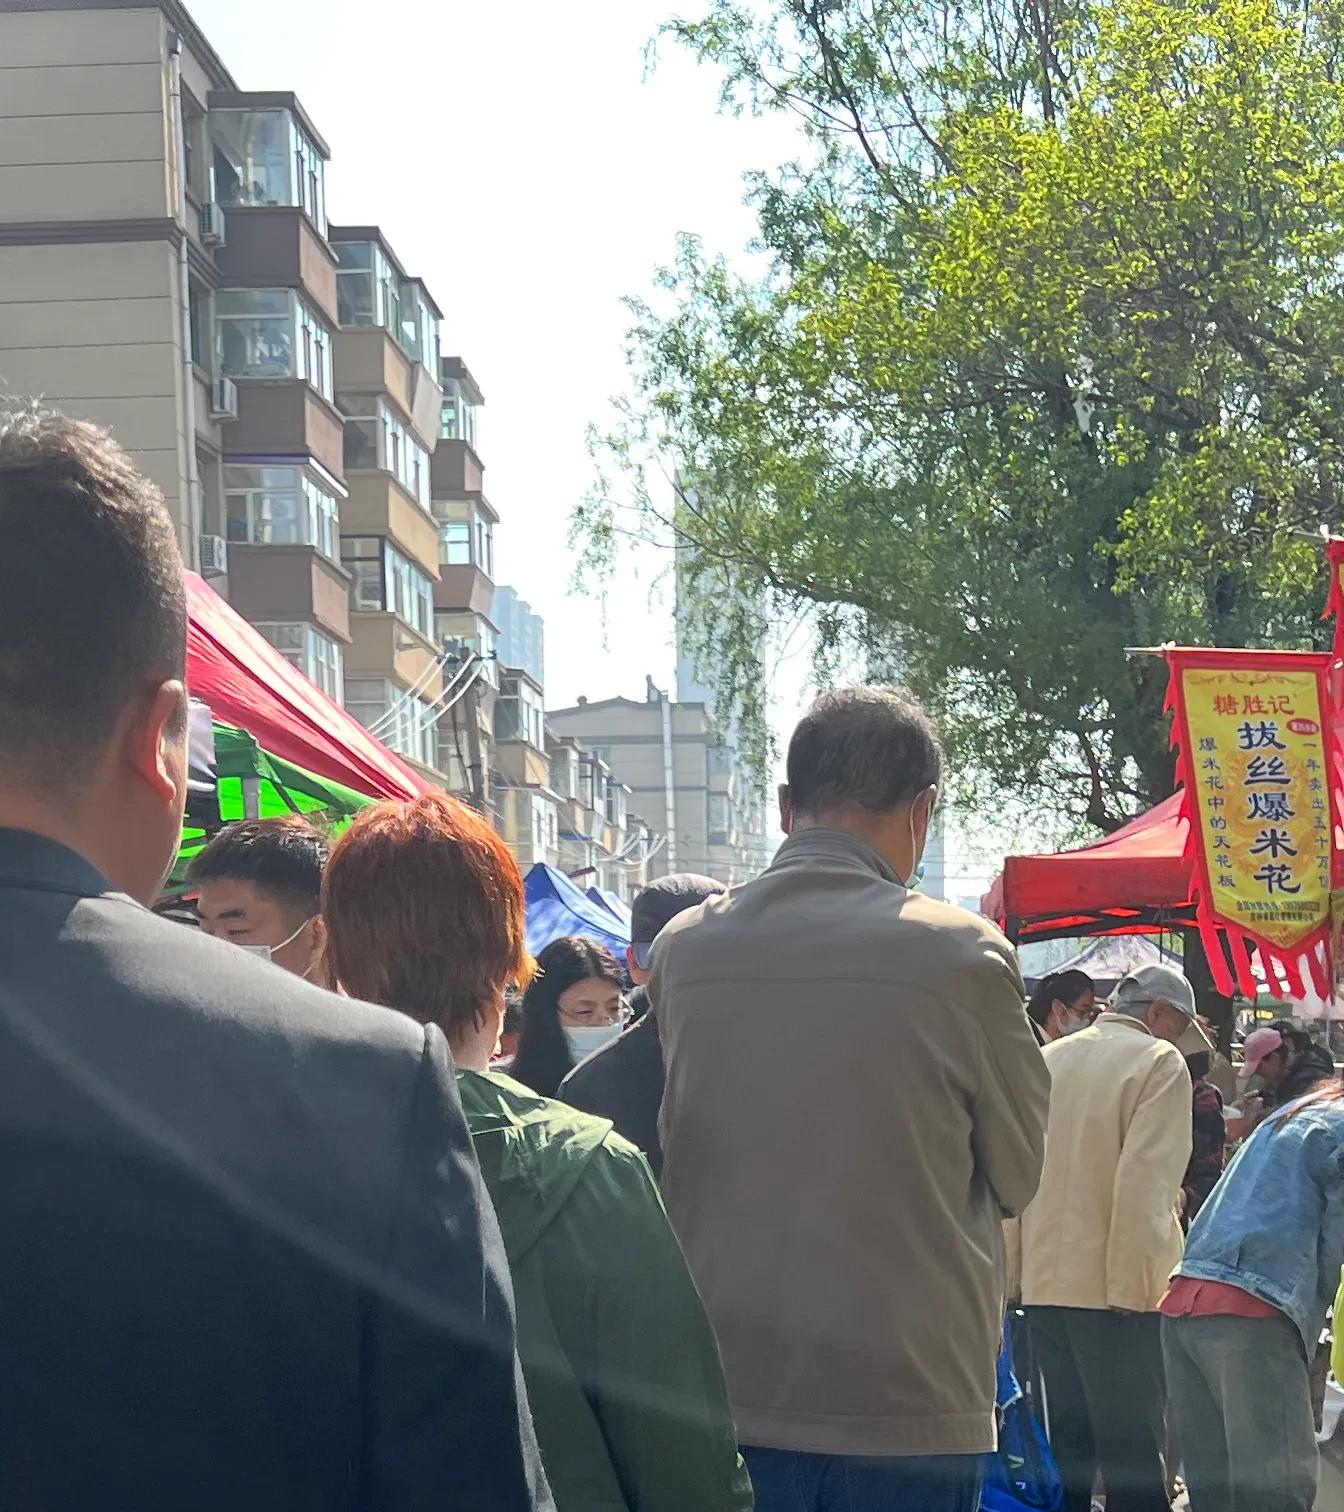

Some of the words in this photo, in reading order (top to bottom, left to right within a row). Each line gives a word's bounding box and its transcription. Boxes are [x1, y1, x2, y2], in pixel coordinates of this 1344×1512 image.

[1213, 694, 1295, 715] 糖胜记
[1199, 737, 1236, 888] 爆米花中的天花板
[1237, 720, 1302, 894] 拔丝爆米花
